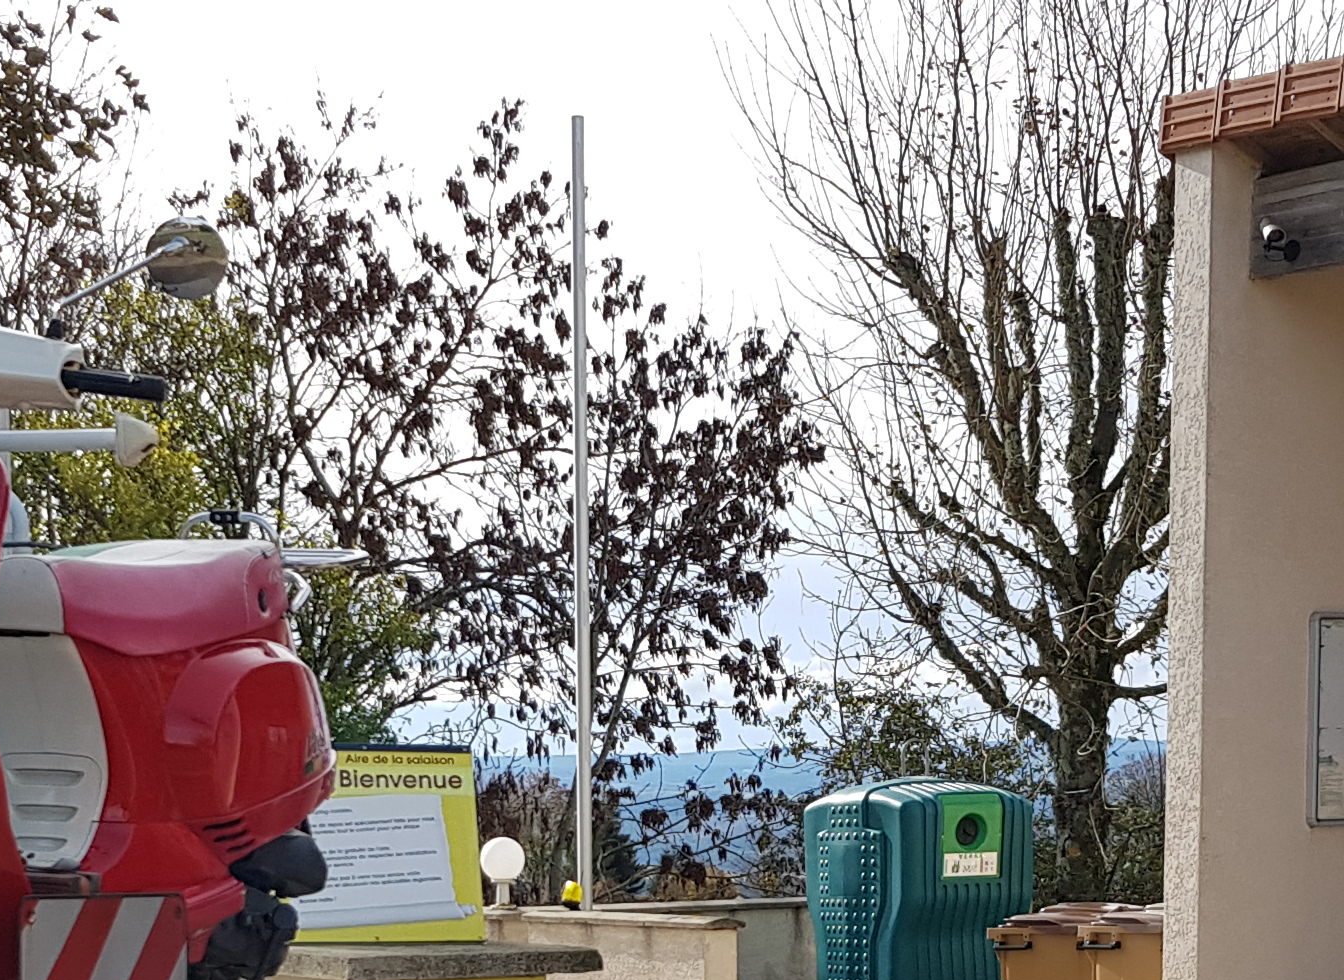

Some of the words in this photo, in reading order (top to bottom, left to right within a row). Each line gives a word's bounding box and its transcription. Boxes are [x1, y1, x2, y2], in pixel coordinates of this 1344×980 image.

[345, 754, 369, 764] Aire
[373, 754, 388, 764] de
[392, 755, 404, 764] la
[407, 755, 455, 765] salaison
[339, 769, 463, 789] Bienvenue
